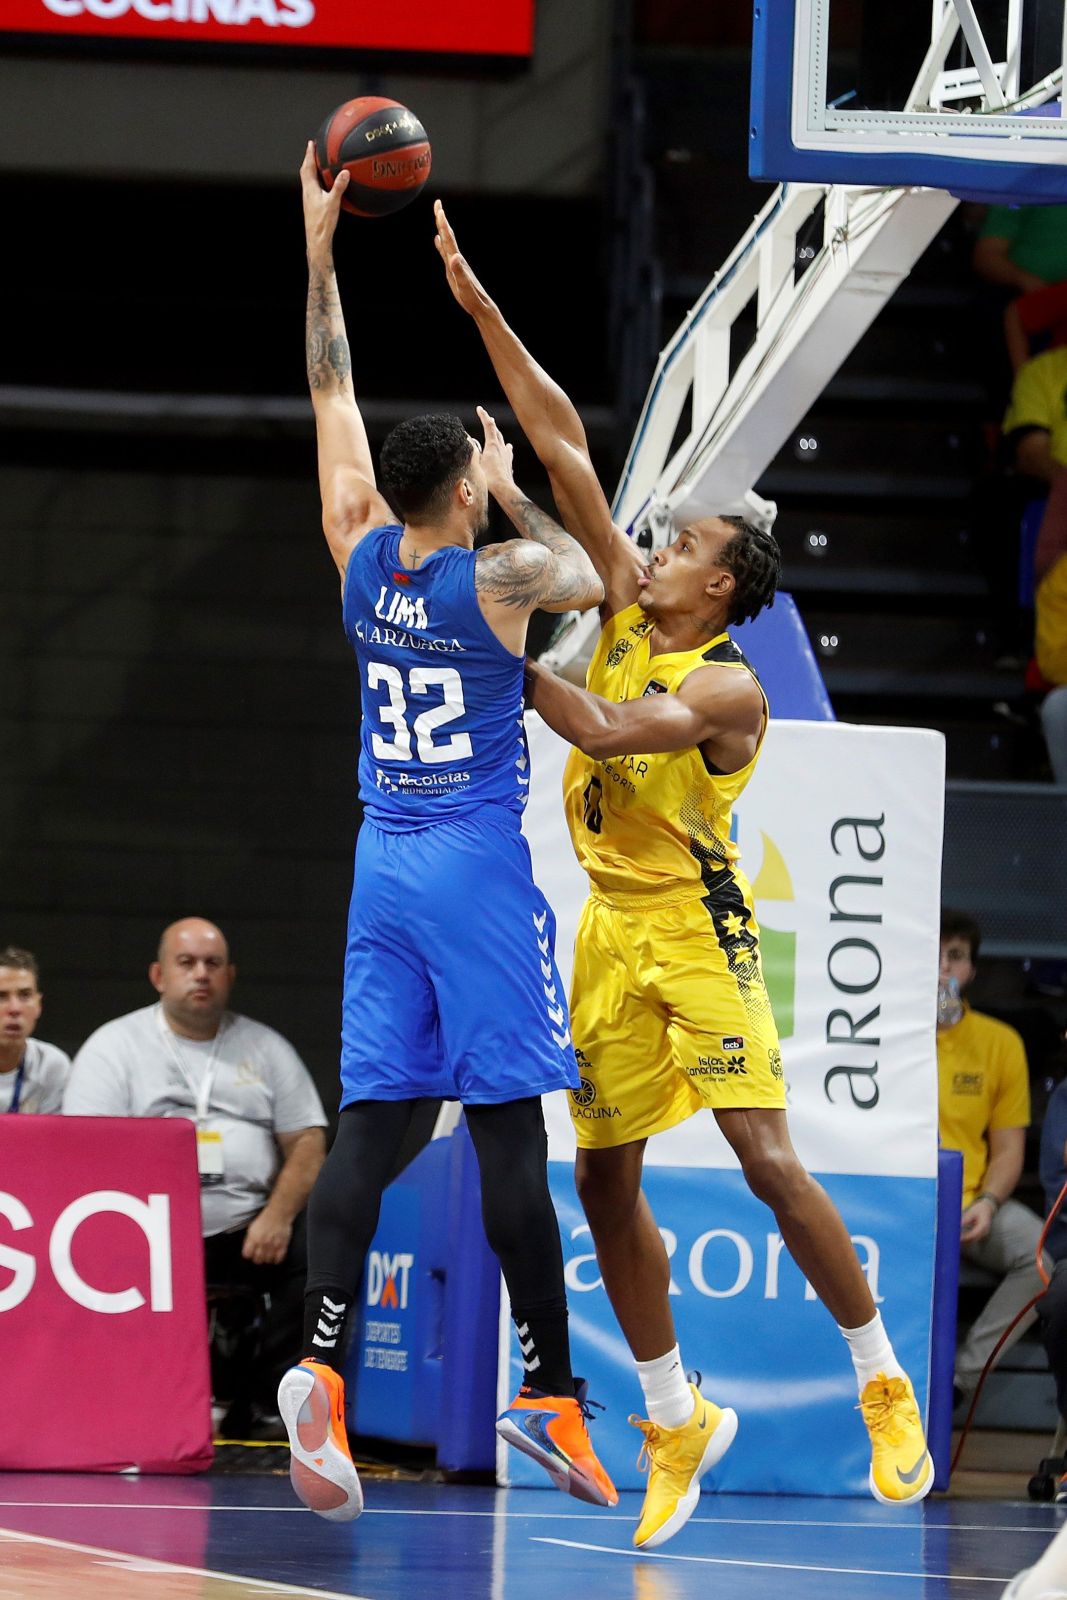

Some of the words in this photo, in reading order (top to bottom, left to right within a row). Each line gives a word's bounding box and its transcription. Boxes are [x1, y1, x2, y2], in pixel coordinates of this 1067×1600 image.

[374, 585, 428, 630] LIMA
[368, 625, 467, 652] ARZUAGA
[367, 661, 474, 764] 32
[398, 771, 471, 787] Recoletas
[723, 1041, 740, 1049] acb
[685, 1065, 726, 1077] Canarias
[698, 1056, 725, 1067] Islas
[367, 1251, 414, 1309] DXT
